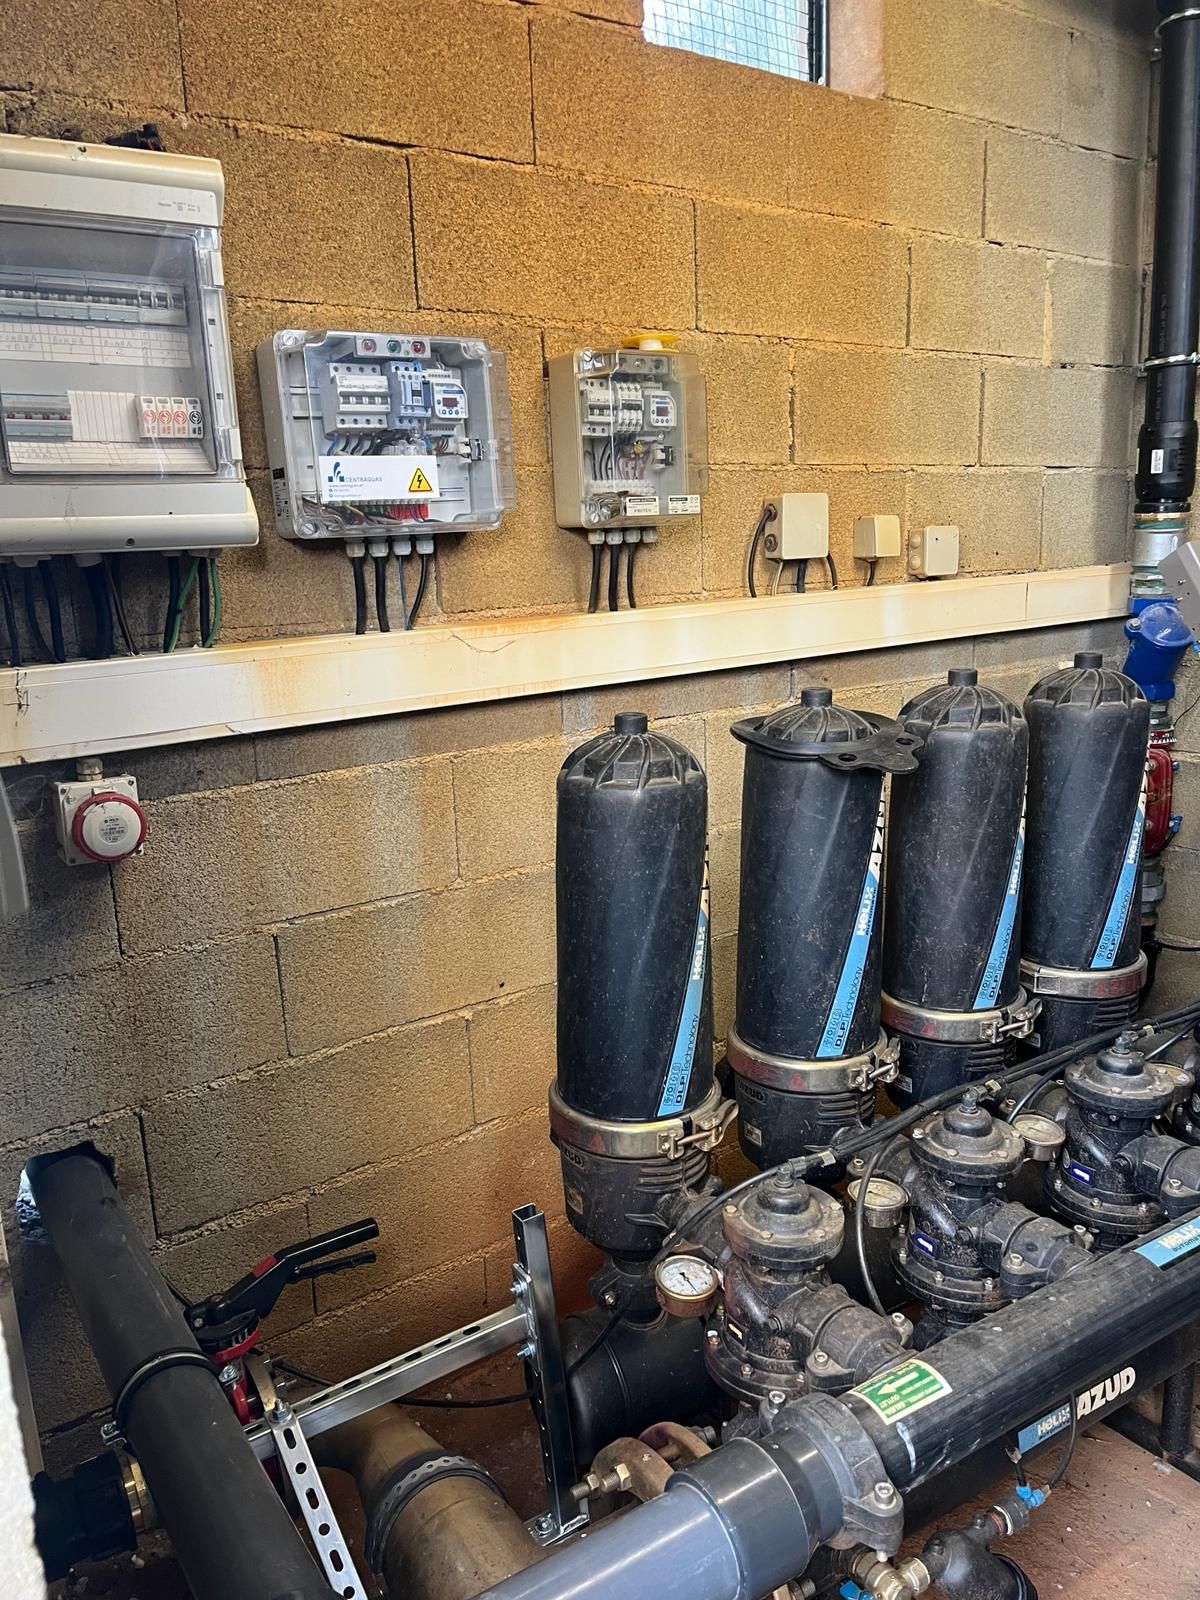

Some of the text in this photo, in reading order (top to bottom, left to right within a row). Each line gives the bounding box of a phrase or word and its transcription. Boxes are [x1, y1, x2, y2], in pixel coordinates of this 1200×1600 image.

[989, 922, 1013, 998] DLP Technology
[1106, 890, 1131, 960] DLP Technology
[835, 966, 863, 1047] DLP Technology
[675, 1014, 699, 1104] DLP Technology
[1076, 1366, 1136, 1420] AZUD
